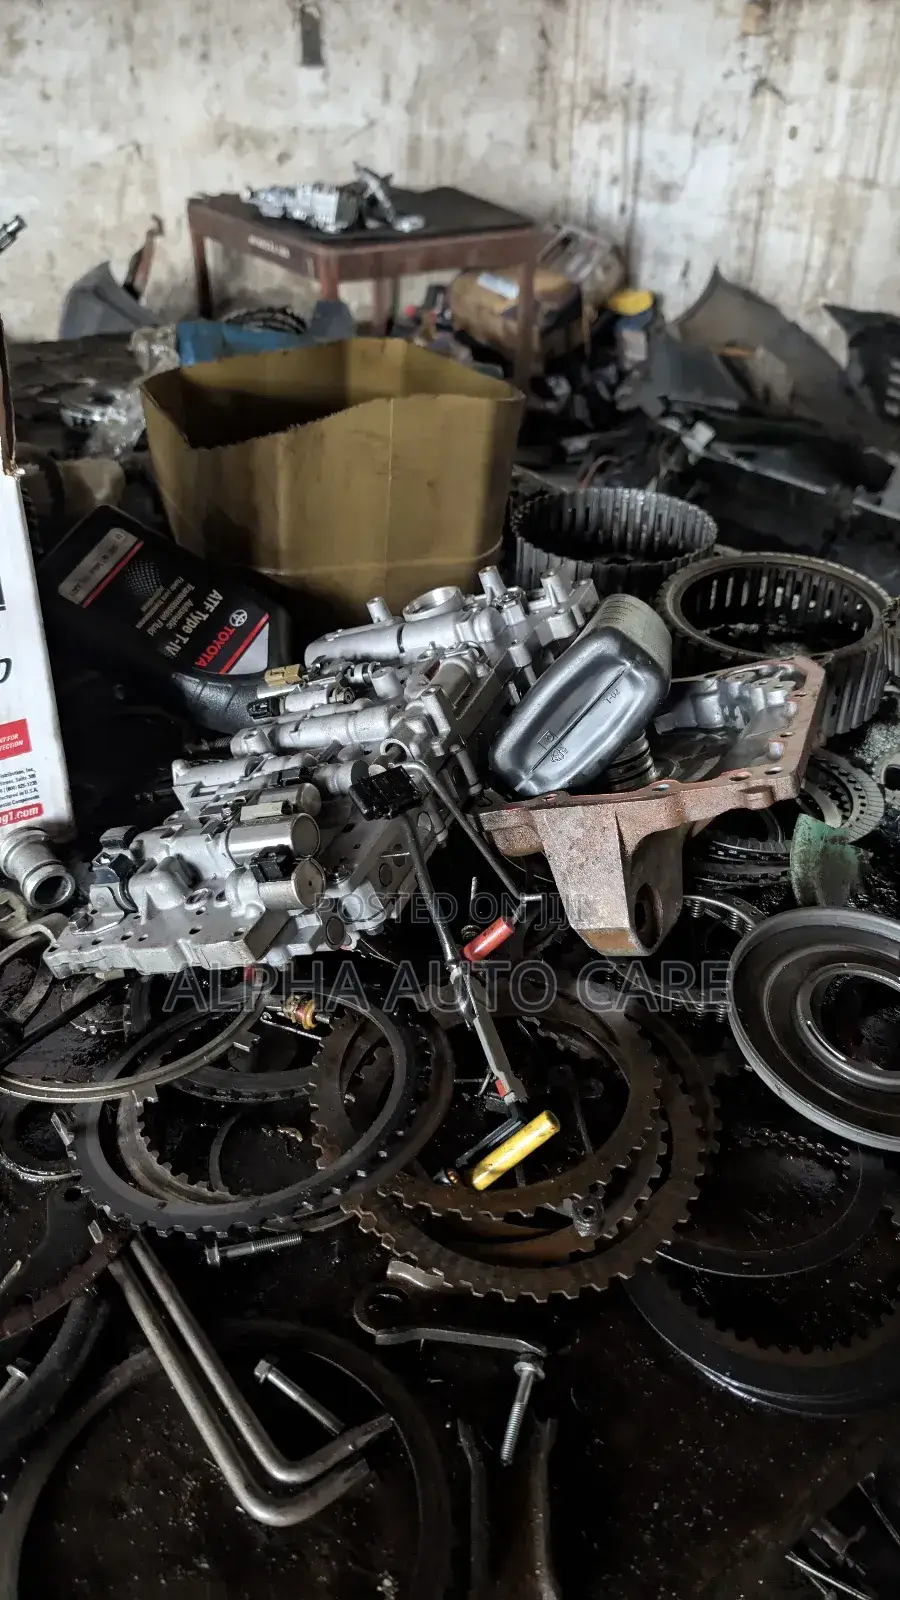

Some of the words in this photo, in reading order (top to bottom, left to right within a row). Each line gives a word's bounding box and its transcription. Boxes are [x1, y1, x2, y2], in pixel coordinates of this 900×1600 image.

[160, 583, 195, 621] Transmission
[203, 589, 223, 613] ATF
[166, 599, 193, 630] Automatic
[182, 610, 209, 634] Type
[147, 619, 164, 636] Fluid
[165, 633, 190, 657] T-IV
[194, 626, 236, 668] TOYOTA
[8, 733, 19, 741] FOR
